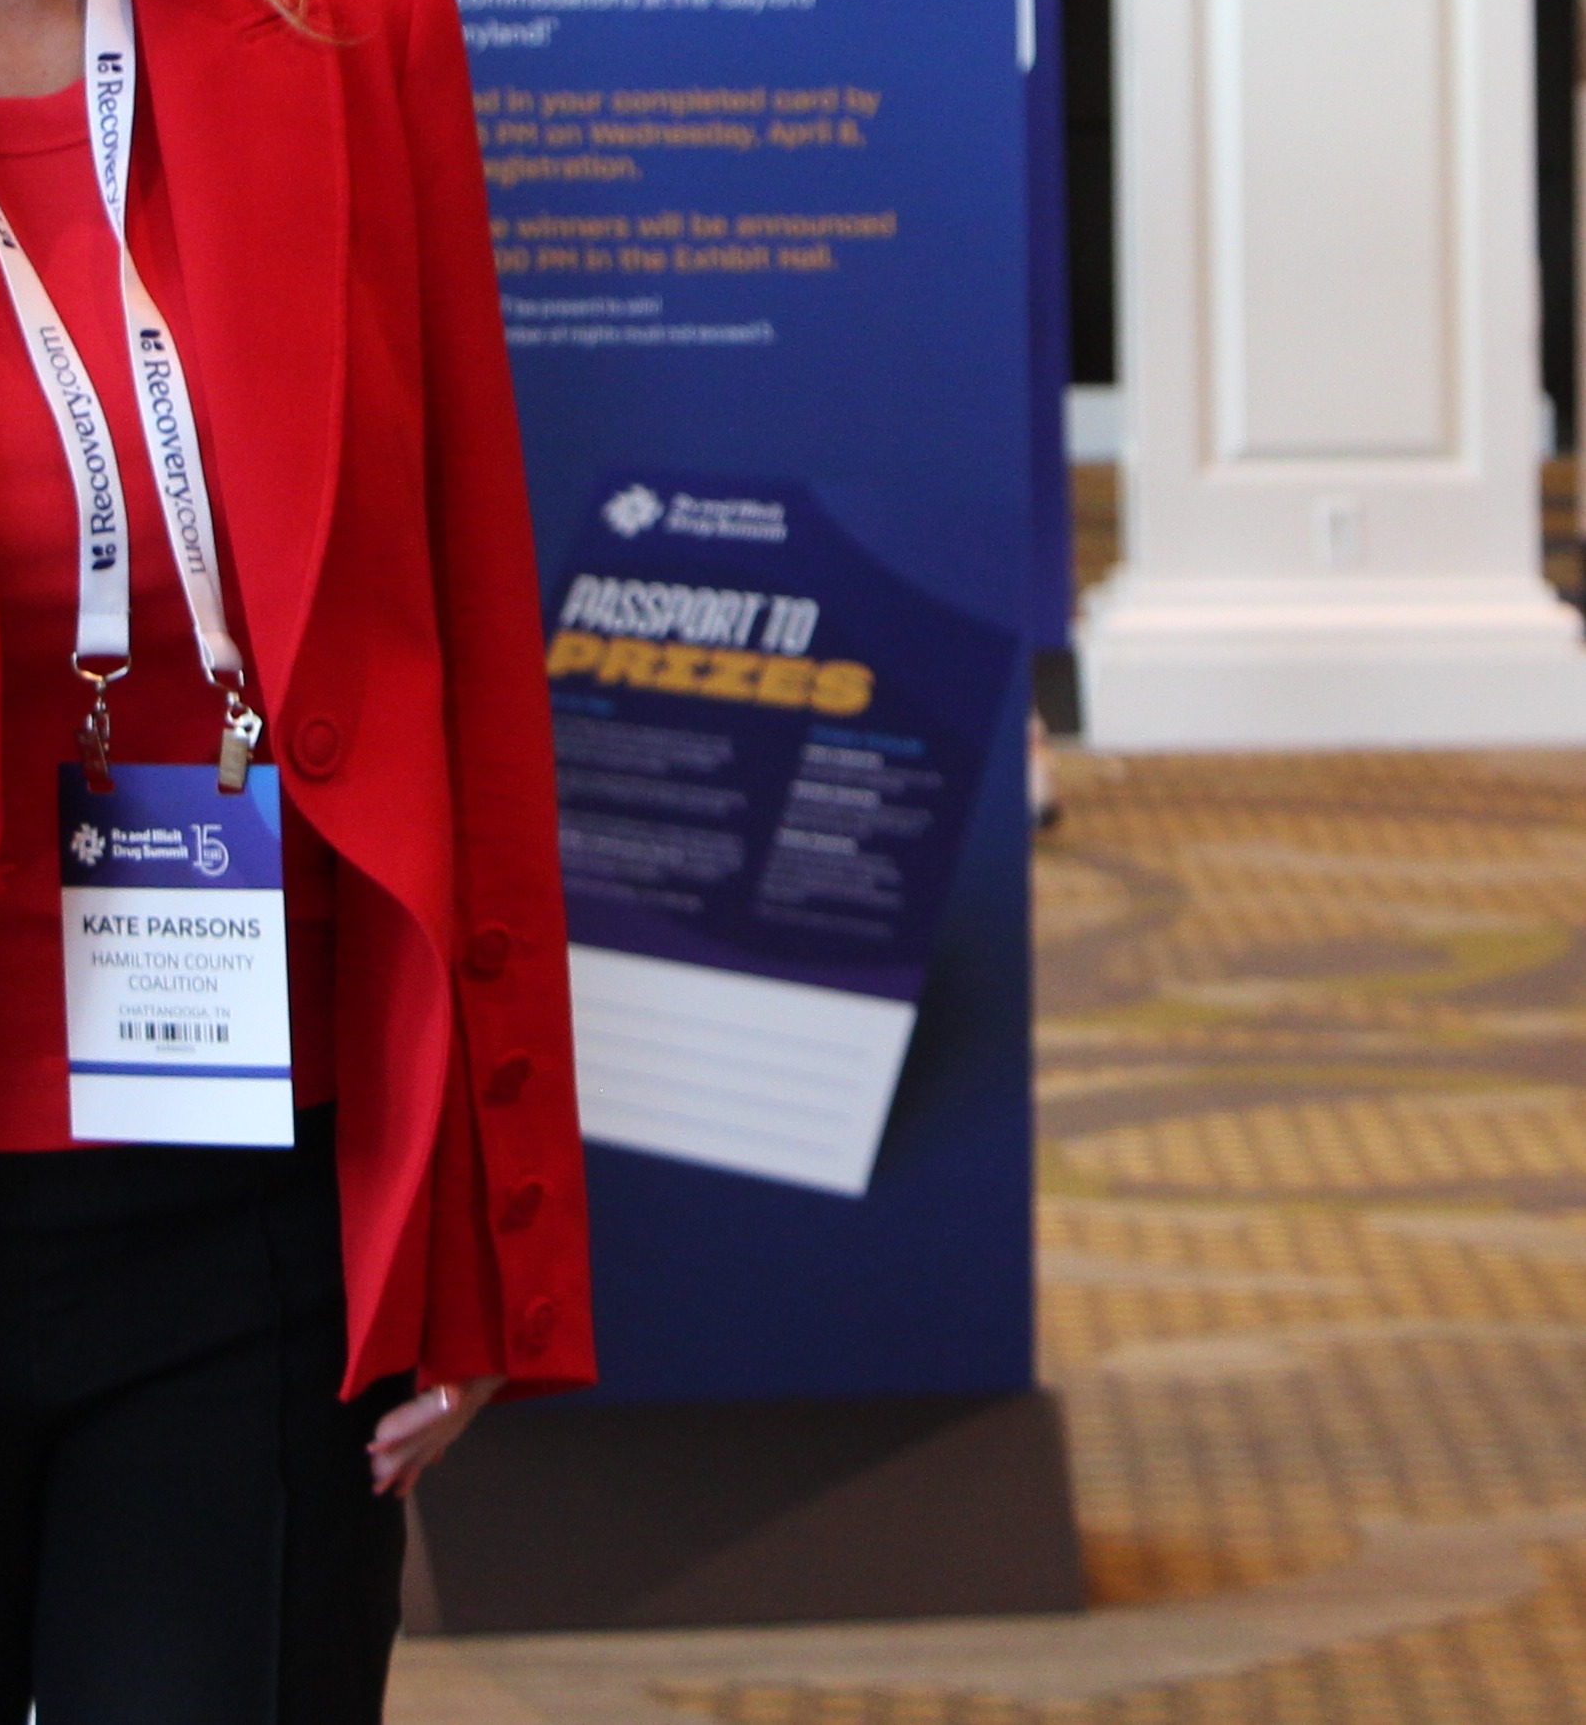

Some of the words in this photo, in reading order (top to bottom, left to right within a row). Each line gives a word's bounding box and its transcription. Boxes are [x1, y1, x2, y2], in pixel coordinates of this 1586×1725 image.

[484, 154, 644, 186] egistration.
[40, 325, 116, 536] Recovery.com
[143, 359, 207, 574] Recovery.com
[560, 573, 756, 651] PASSPORT
[760, 595, 819, 656] TO
[545, 631, 876, 716] PRIZES
[129, 828, 150, 842] and
[112, 844, 141, 861] Drug
[143, 844, 189, 860] Summit
[83, 914, 140, 937] KATE
[147, 916, 261, 939] PARSONS
[92, 951, 179, 970] HAMILTON
[184, 953, 254, 971] COUNTY
[128, 975, 218, 993] COALITION
[215, 1006, 231, 1019] TN
